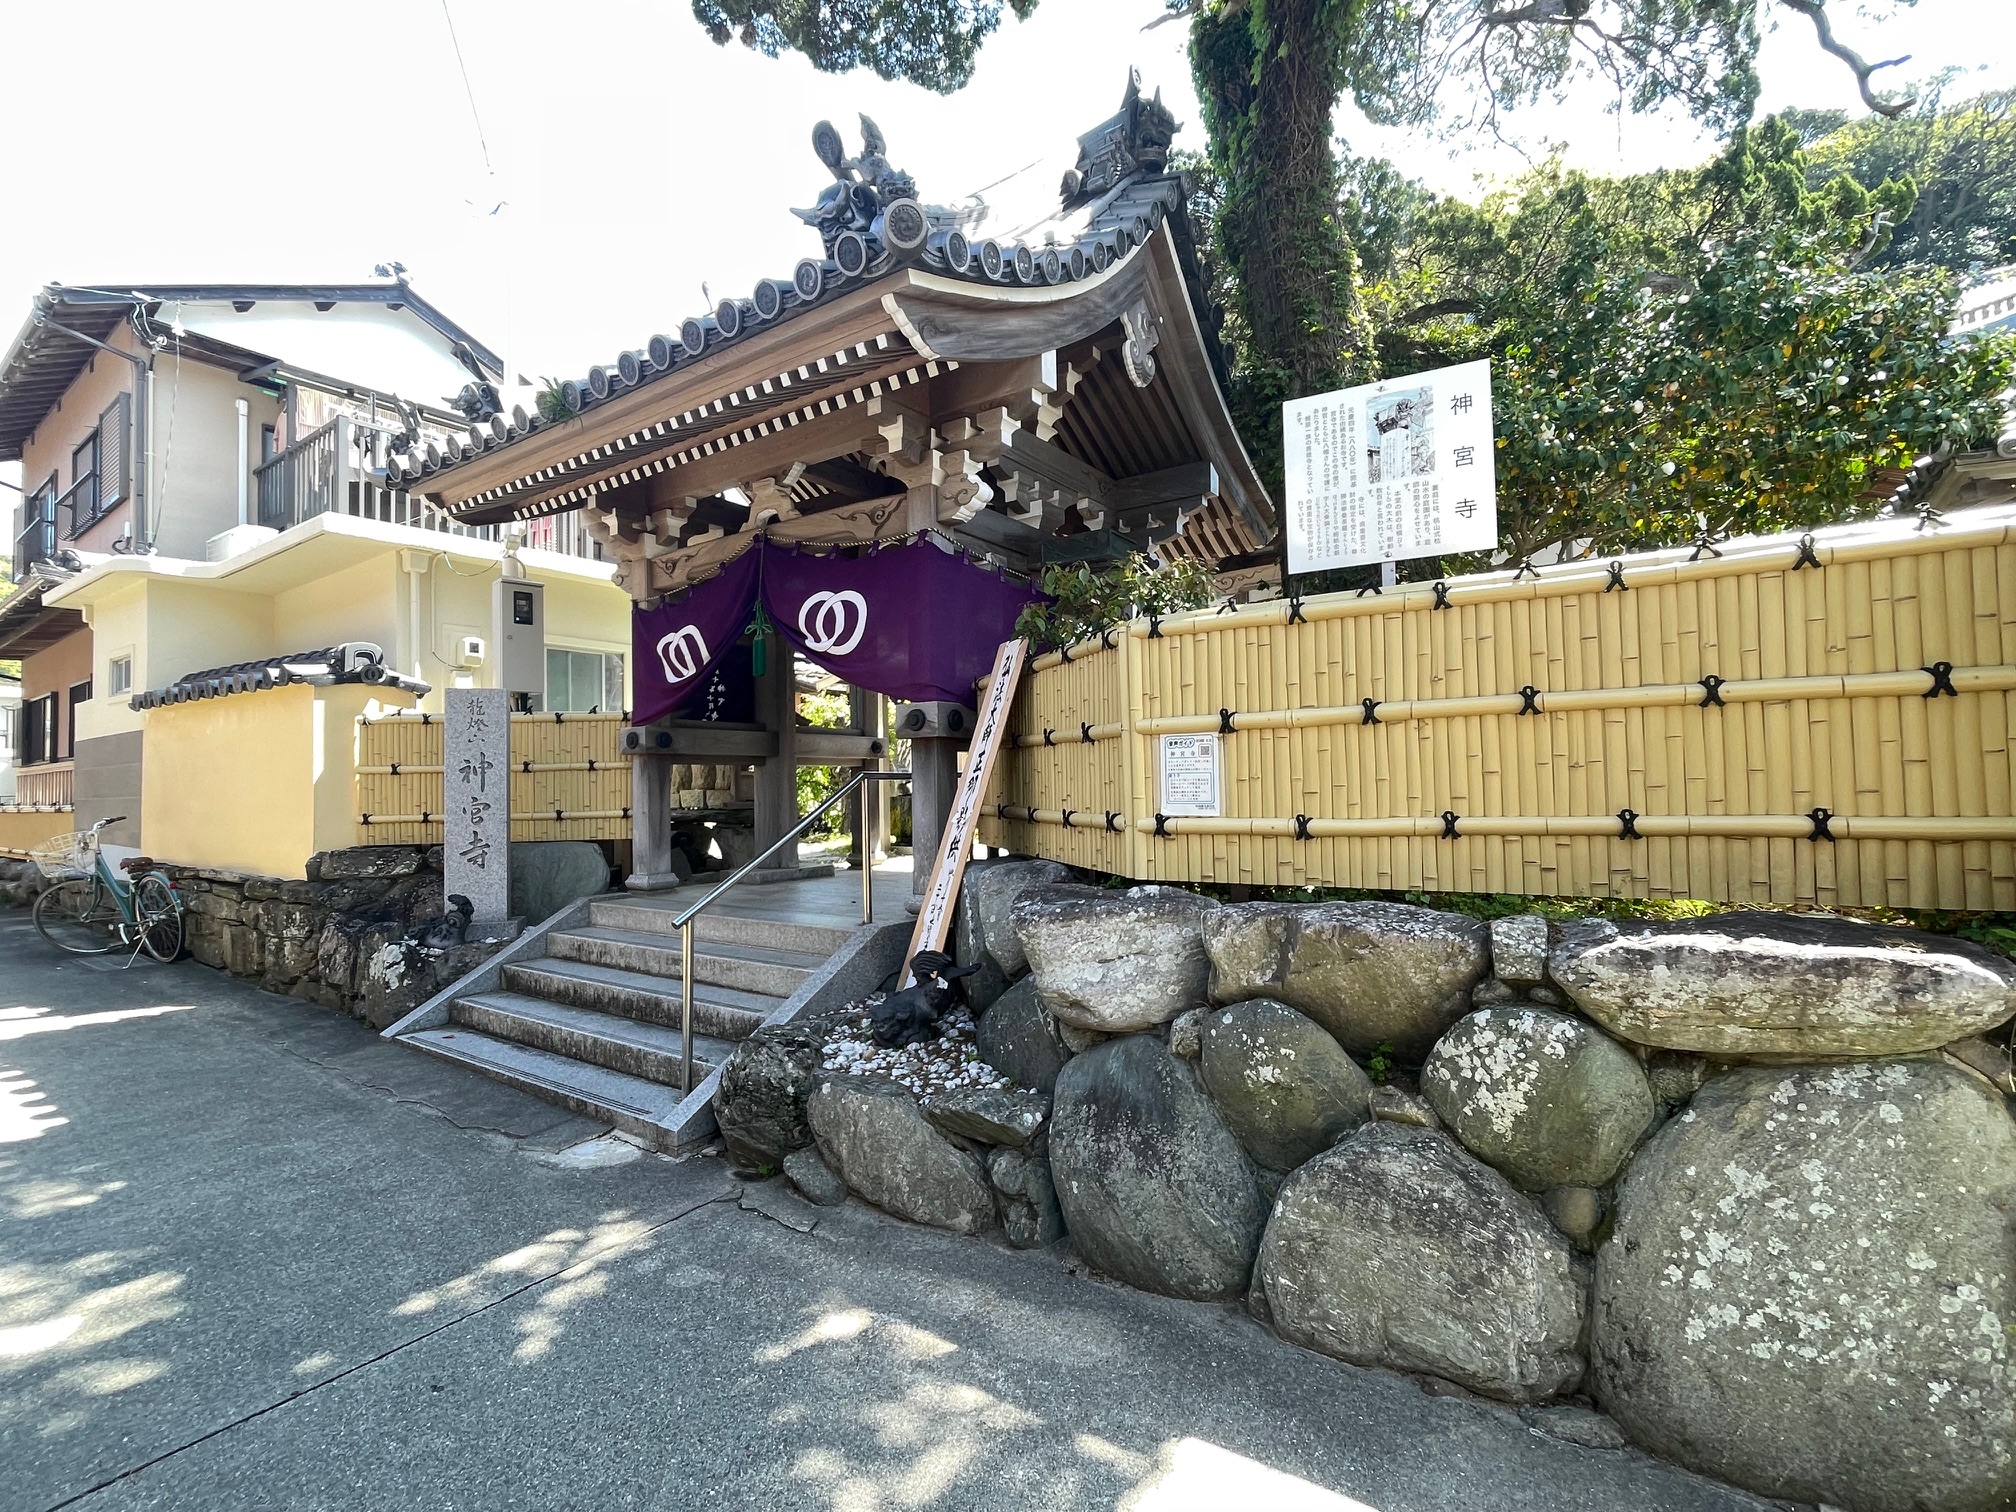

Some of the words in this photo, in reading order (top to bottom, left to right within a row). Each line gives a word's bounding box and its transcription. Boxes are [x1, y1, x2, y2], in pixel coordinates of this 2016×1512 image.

[1450, 392, 1478, 519] 神宮寺
[466, 697, 489, 743] 龍燈山
[458, 751, 494, 870] 神宮寺
